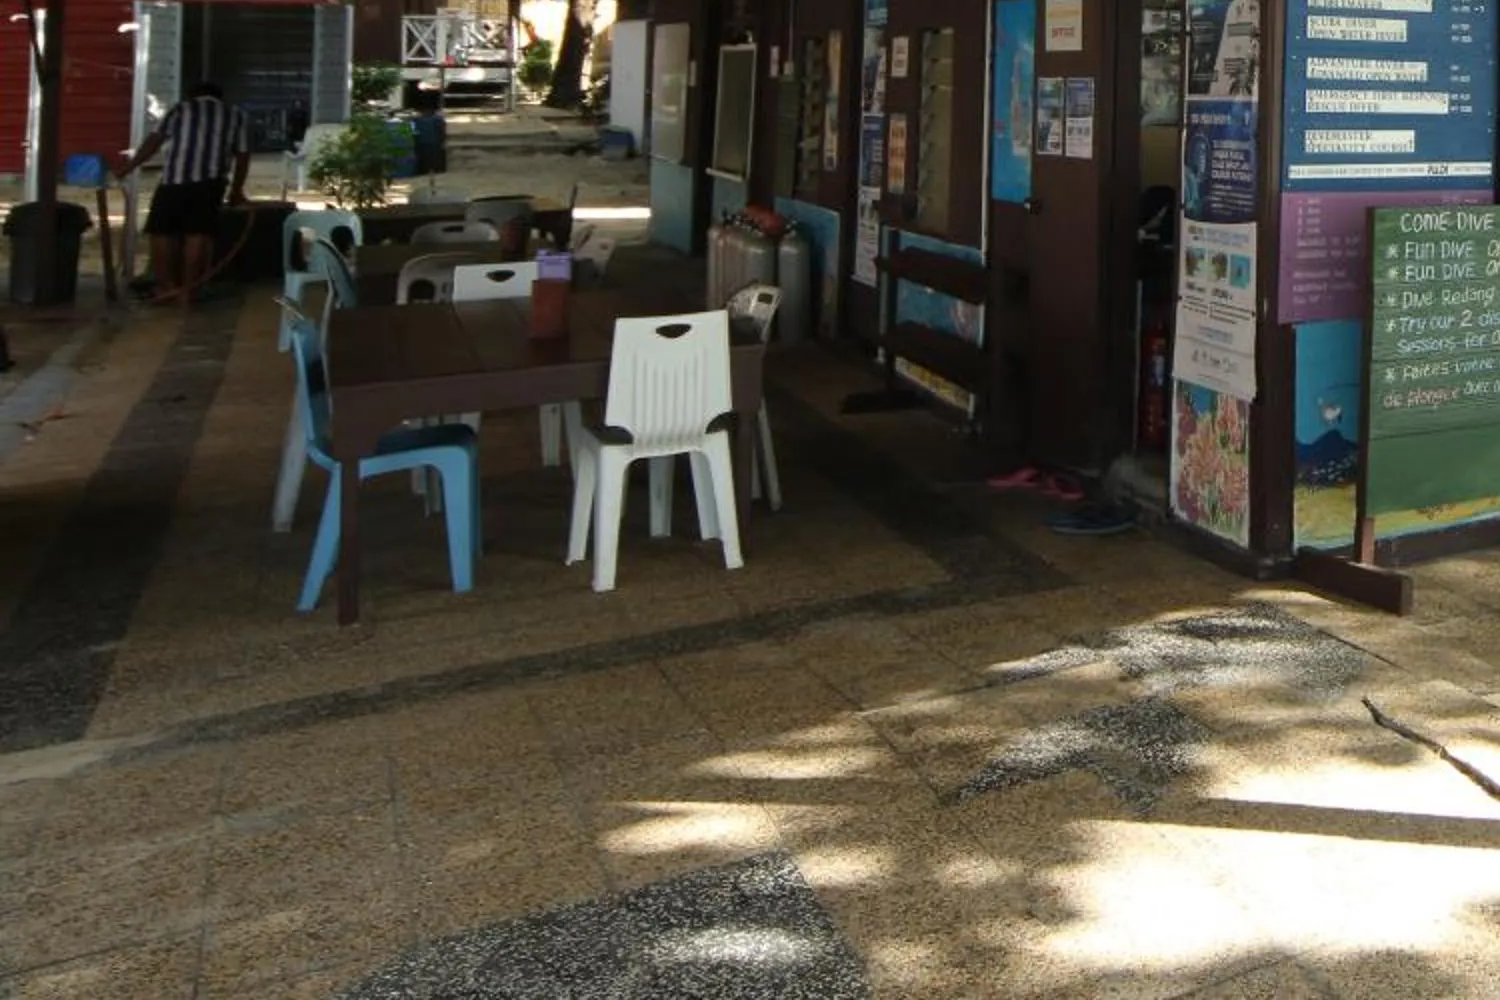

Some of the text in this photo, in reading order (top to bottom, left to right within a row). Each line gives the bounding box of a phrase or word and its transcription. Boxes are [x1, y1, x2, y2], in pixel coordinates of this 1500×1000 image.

[1401, 211, 1452, 233] COME
[1457, 211, 1495, 232] DIVE
[1441, 240, 1475, 259] DIVE
[1443, 263, 1477, 280] DIVE
[1461, 309, 1473, 327] 2
